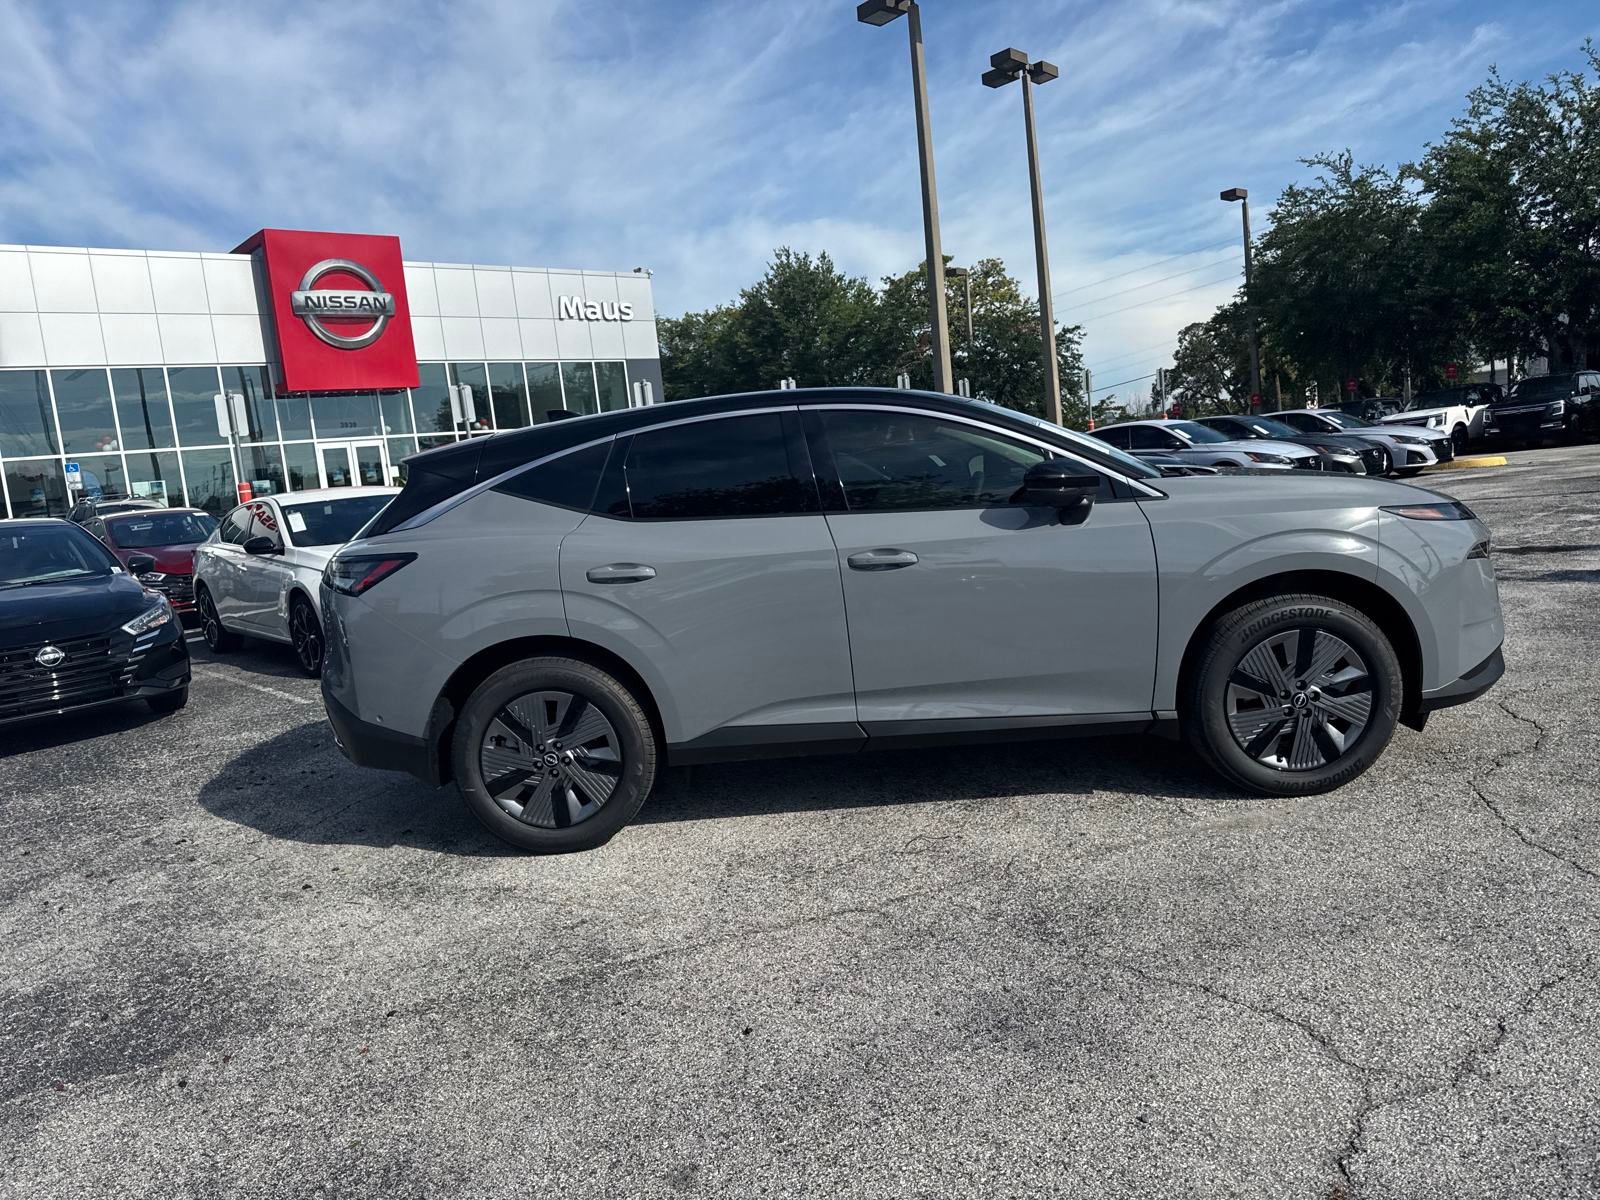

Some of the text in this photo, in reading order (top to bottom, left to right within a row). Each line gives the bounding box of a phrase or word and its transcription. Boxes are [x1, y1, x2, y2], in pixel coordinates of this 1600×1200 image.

[304, 295, 387, 310] NISSAN
[558, 295, 634, 322] Maus
[1241, 607, 1333, 644] BRIDGESTONE
